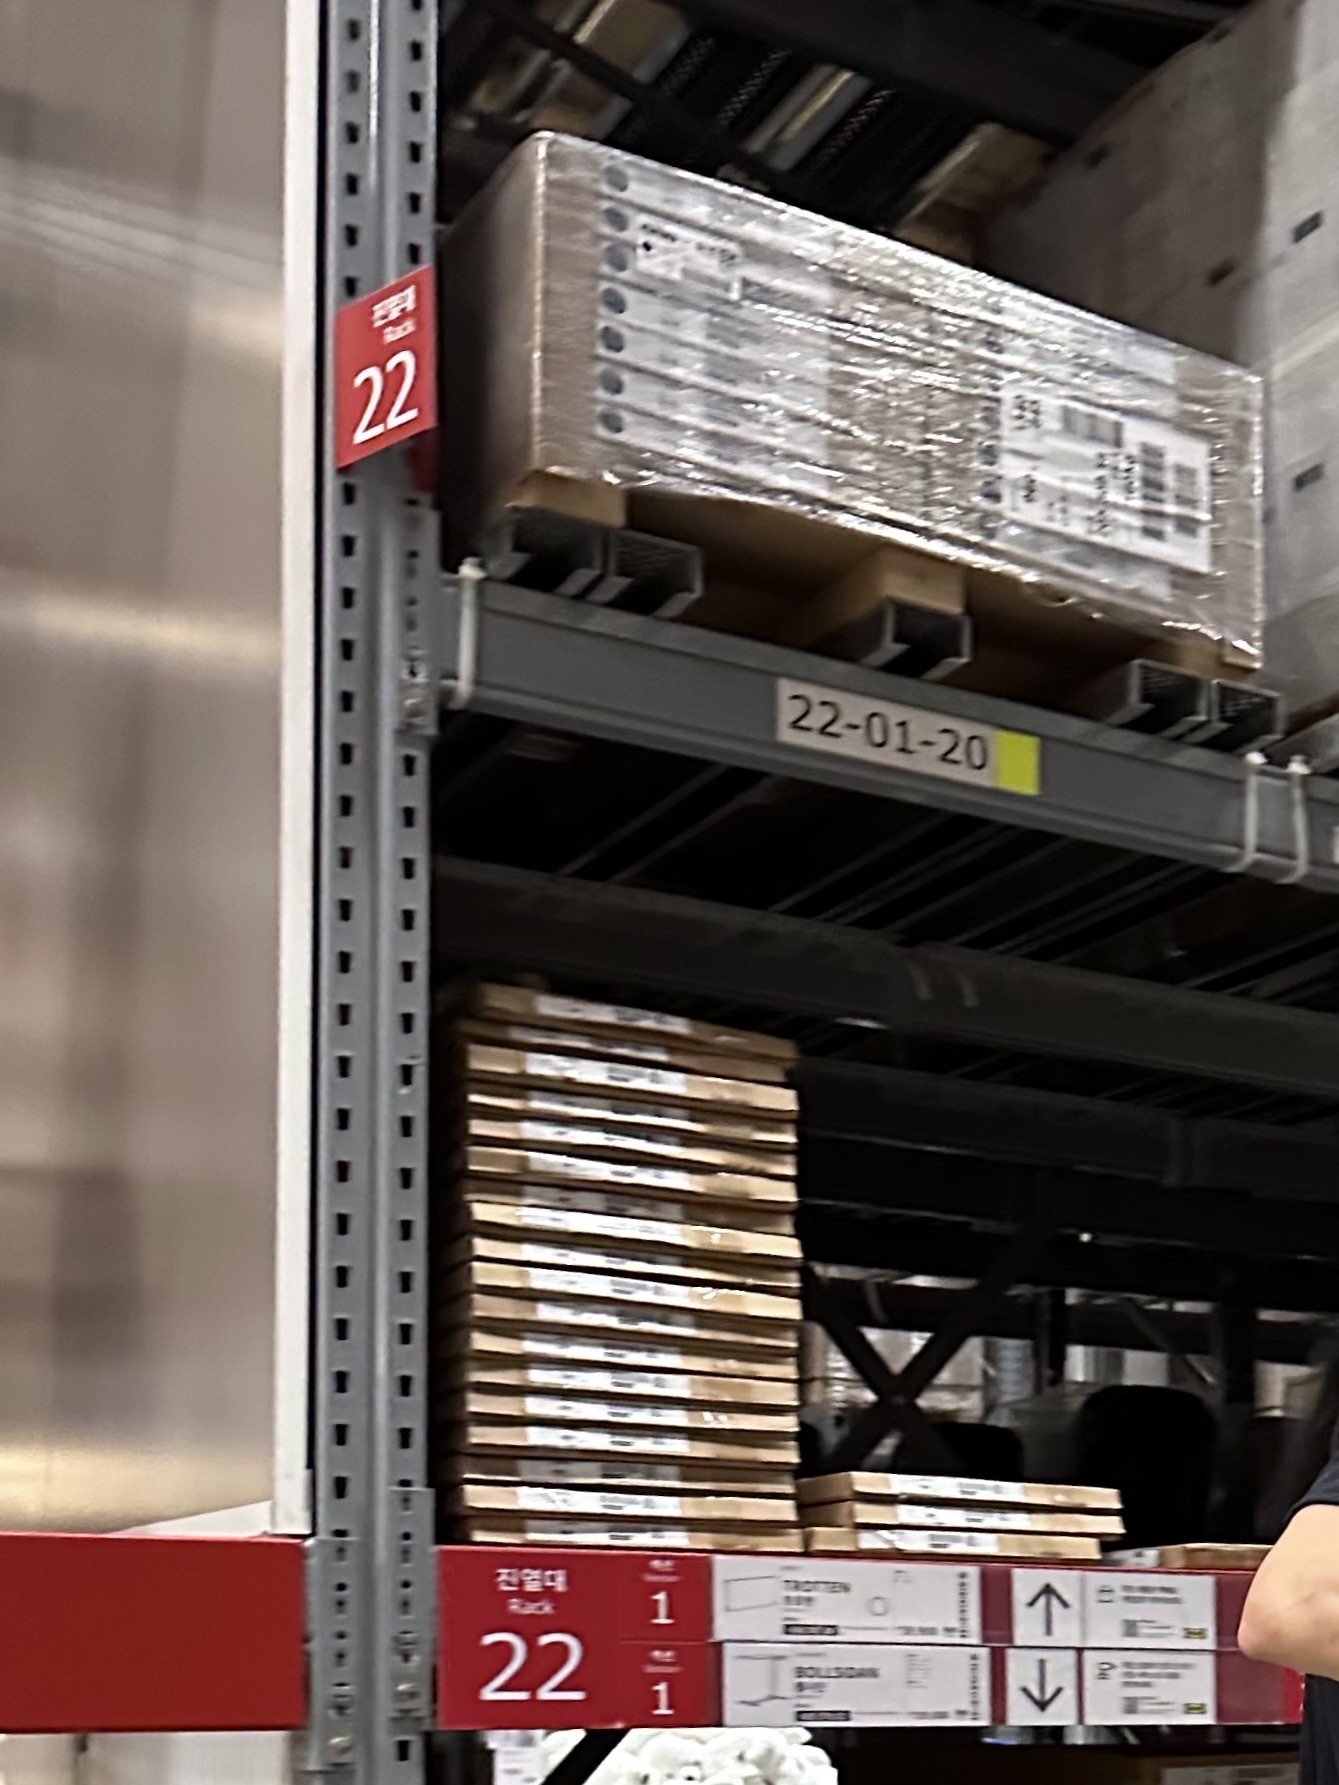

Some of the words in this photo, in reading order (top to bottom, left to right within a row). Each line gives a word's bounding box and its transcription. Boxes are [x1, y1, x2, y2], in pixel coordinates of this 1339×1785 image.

[353, 350, 419, 445] 22
[787, 694, 989, 771] 22-01-20
[495, 1568, 568, 1593] 진열대
[507, 1598, 556, 1615] Rack
[650, 1591, 676, 1625] 1
[479, 1632, 587, 1701] 22
[651, 1681, 676, 1716] 1
